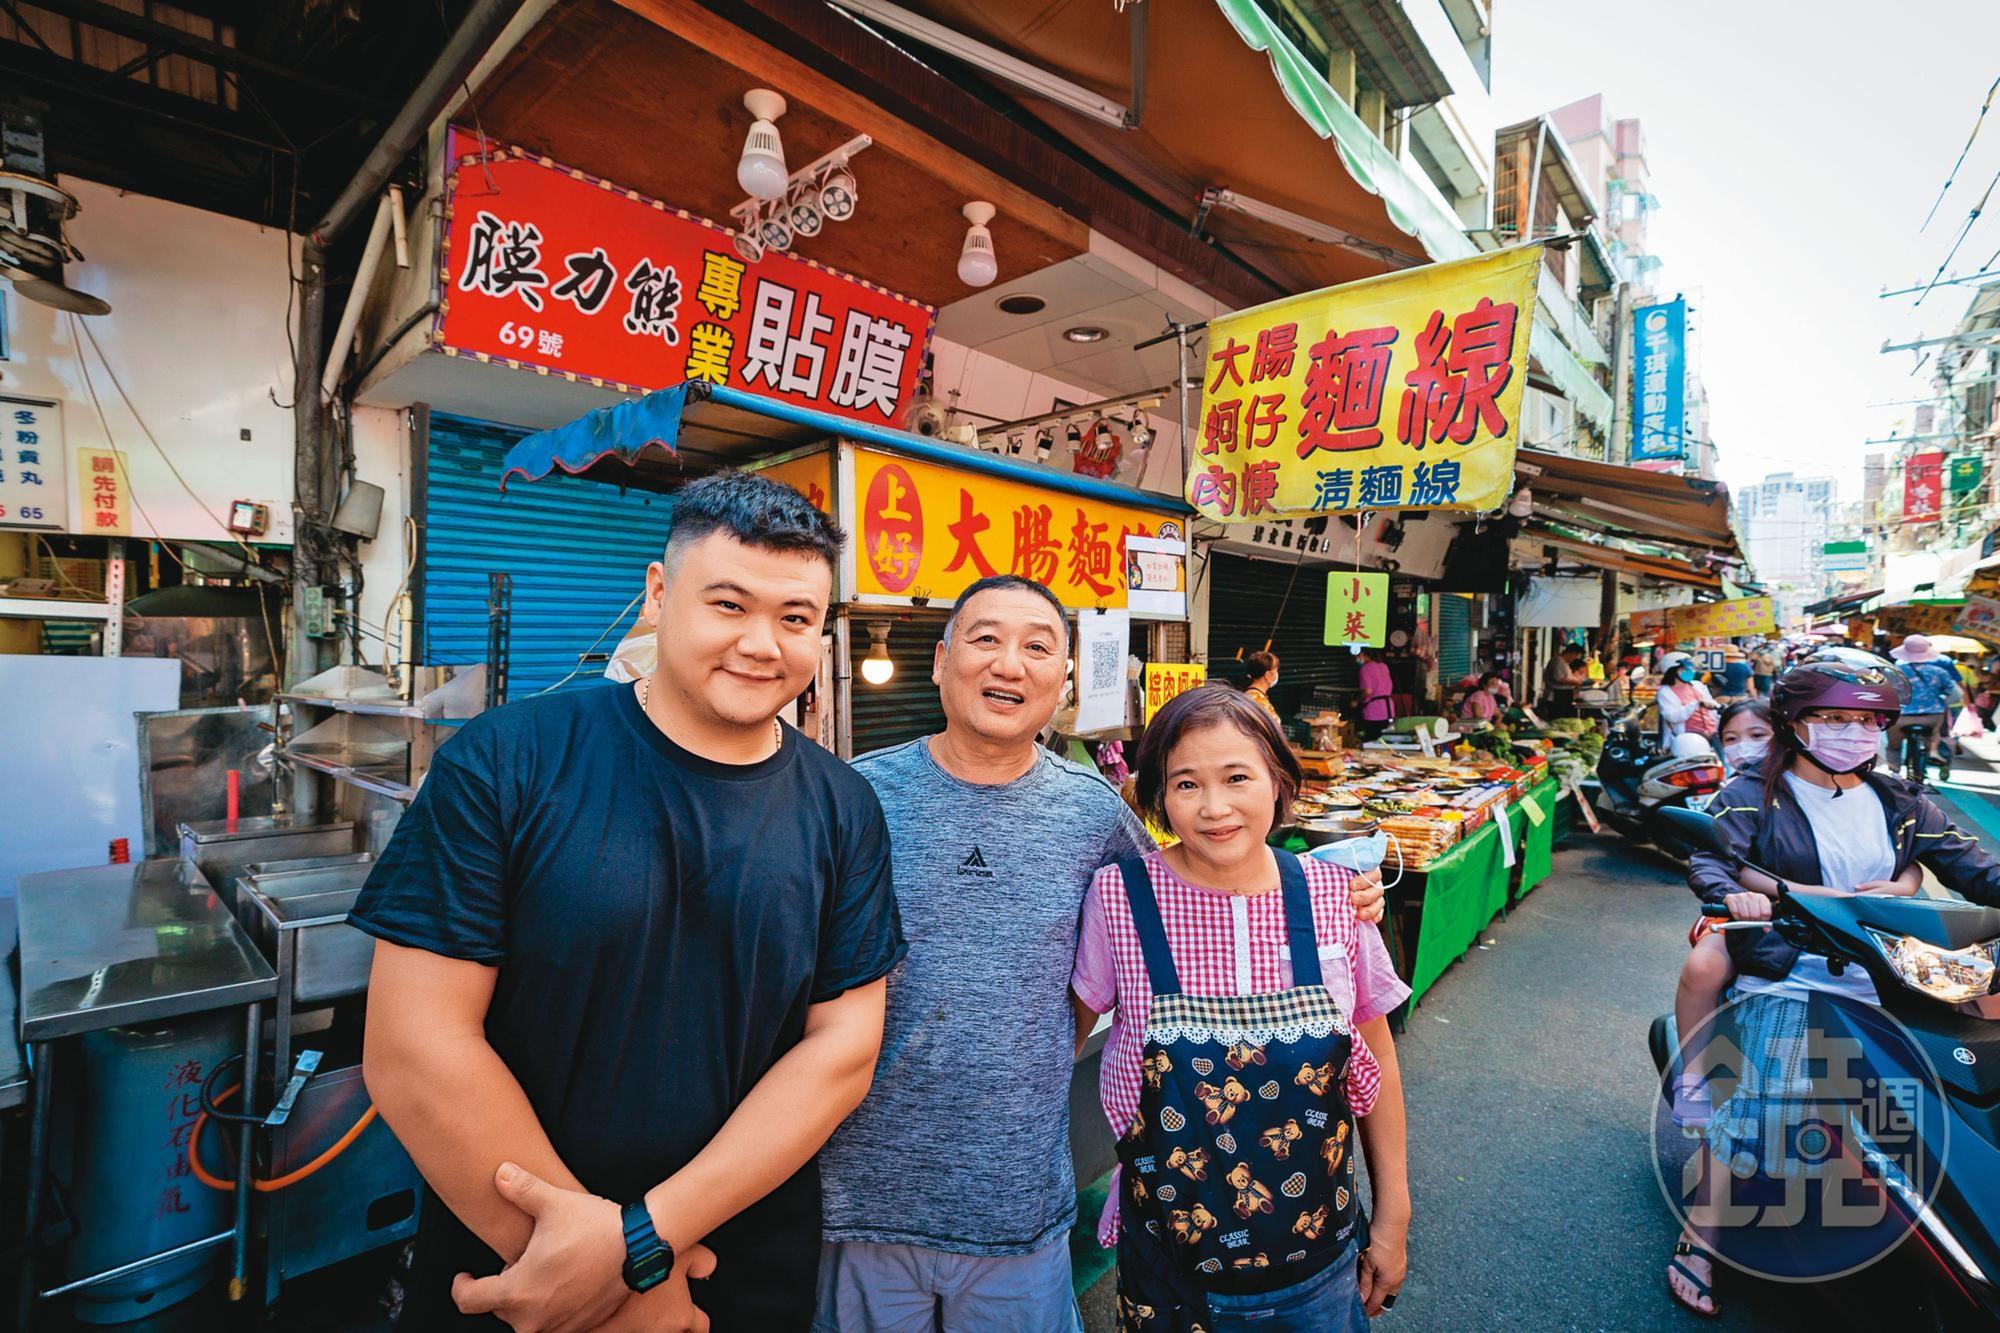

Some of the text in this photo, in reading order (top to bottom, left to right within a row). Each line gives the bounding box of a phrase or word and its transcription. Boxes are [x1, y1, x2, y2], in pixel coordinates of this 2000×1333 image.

[460, 211, 682, 347] 膜力熊
[499, 320, 563, 360] 69號
[685, 249, 748, 387] 專業
[742, 279, 913, 418] 貼膜
[1209, 322, 1298, 394] 大腸
[1296, 296, 1519, 461] 麵線
[14, 409, 43, 486] 冬粉貢丸
[1201, 393, 1288, 456] 蚵仔
[20, 506, 43, 520] 65
[91, 456, 119, 528] 請先付款
[1311, 459, 1463, 511] 清麵線
[873, 472, 918, 580] 上好
[1342, 577, 1370, 641] 小菜
[1219, 1229, 1250, 1243] CLASSIC
[1226, 1237, 1251, 1249] BEAR
